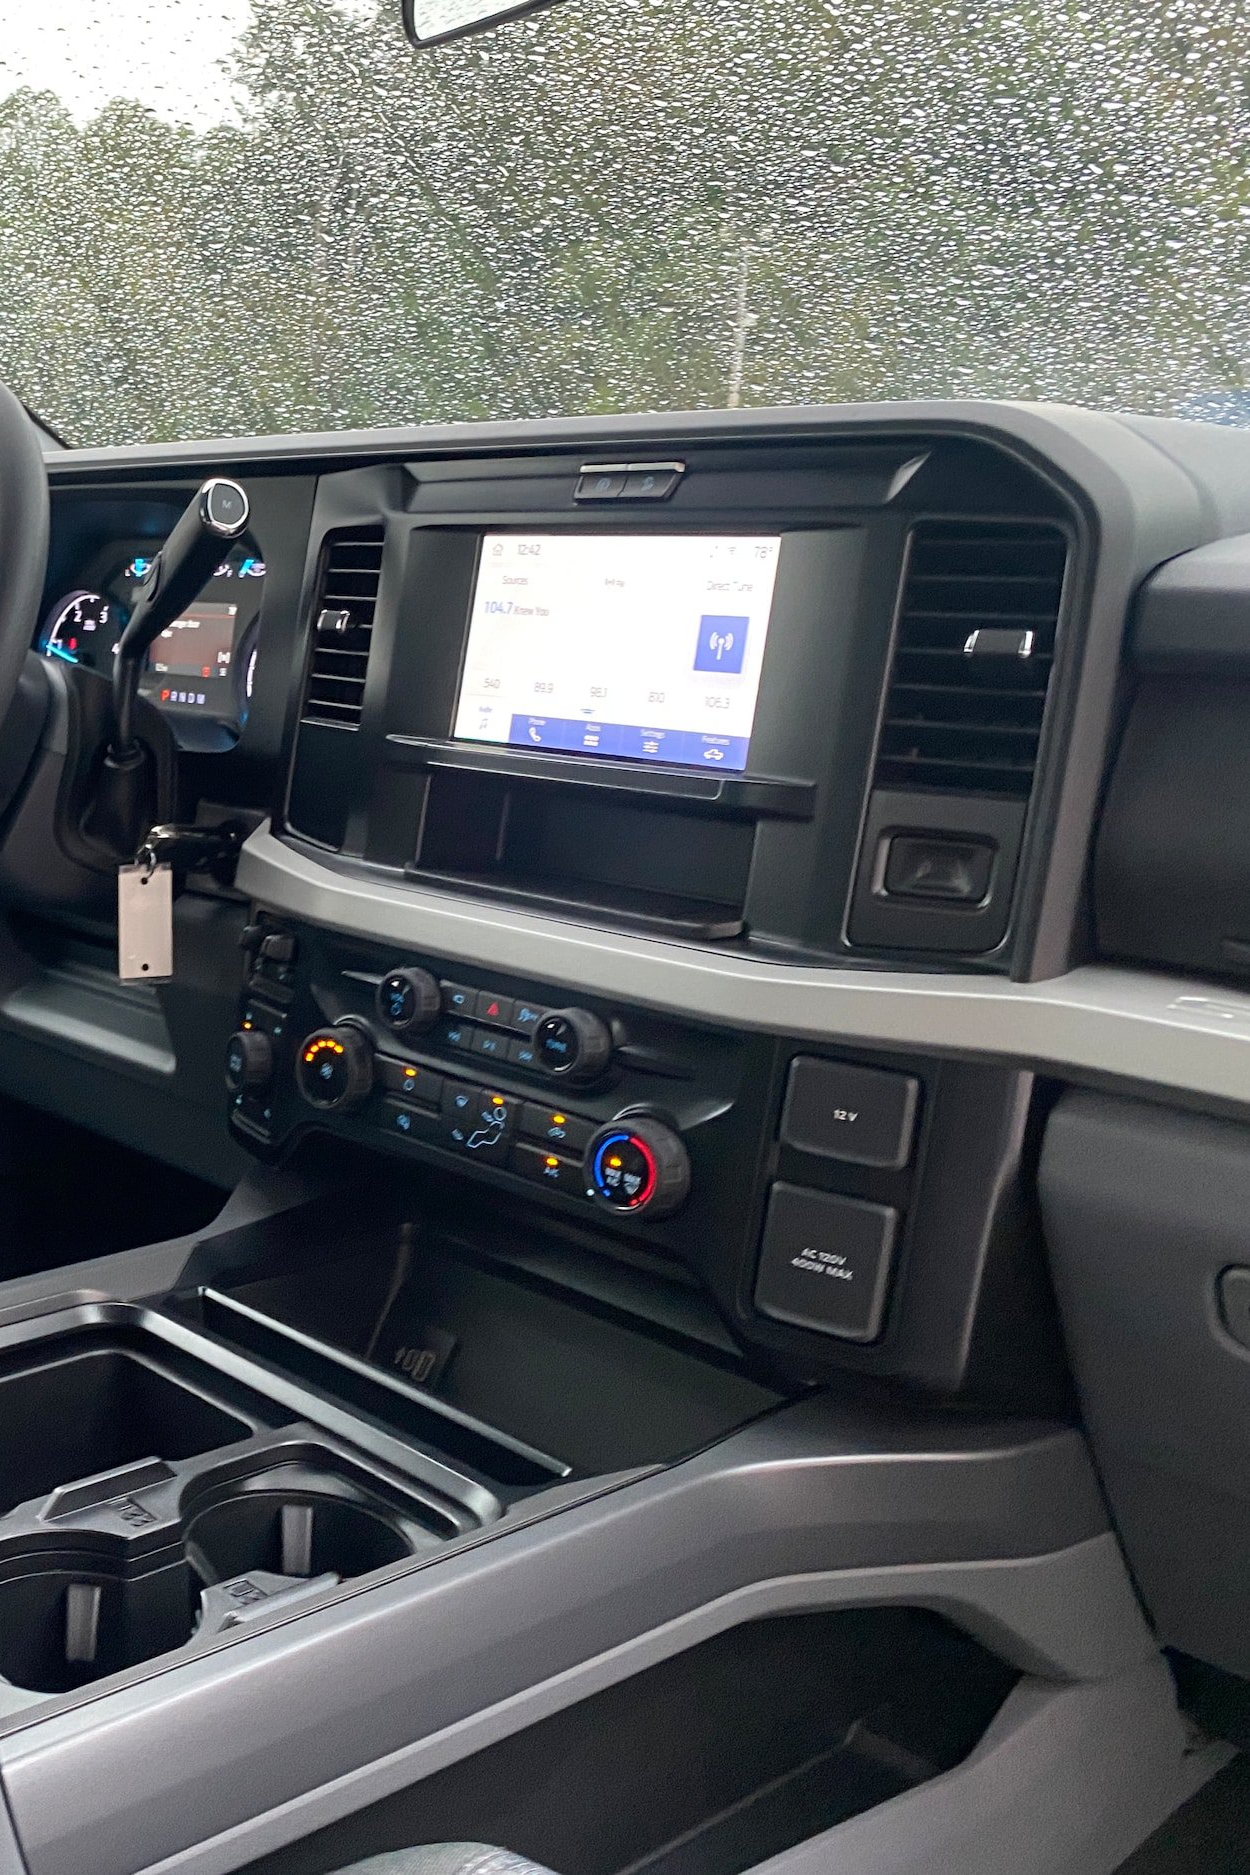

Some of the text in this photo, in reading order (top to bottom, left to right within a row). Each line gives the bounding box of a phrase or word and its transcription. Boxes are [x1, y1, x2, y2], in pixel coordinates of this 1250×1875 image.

[484, 600, 514, 615] 104.7
[73, 610, 83, 623] 2
[98, 611, 109, 624] 3
[801, 1247, 848, 1266] AC 120V
[791, 1257, 854, 1281] 400W MAX
